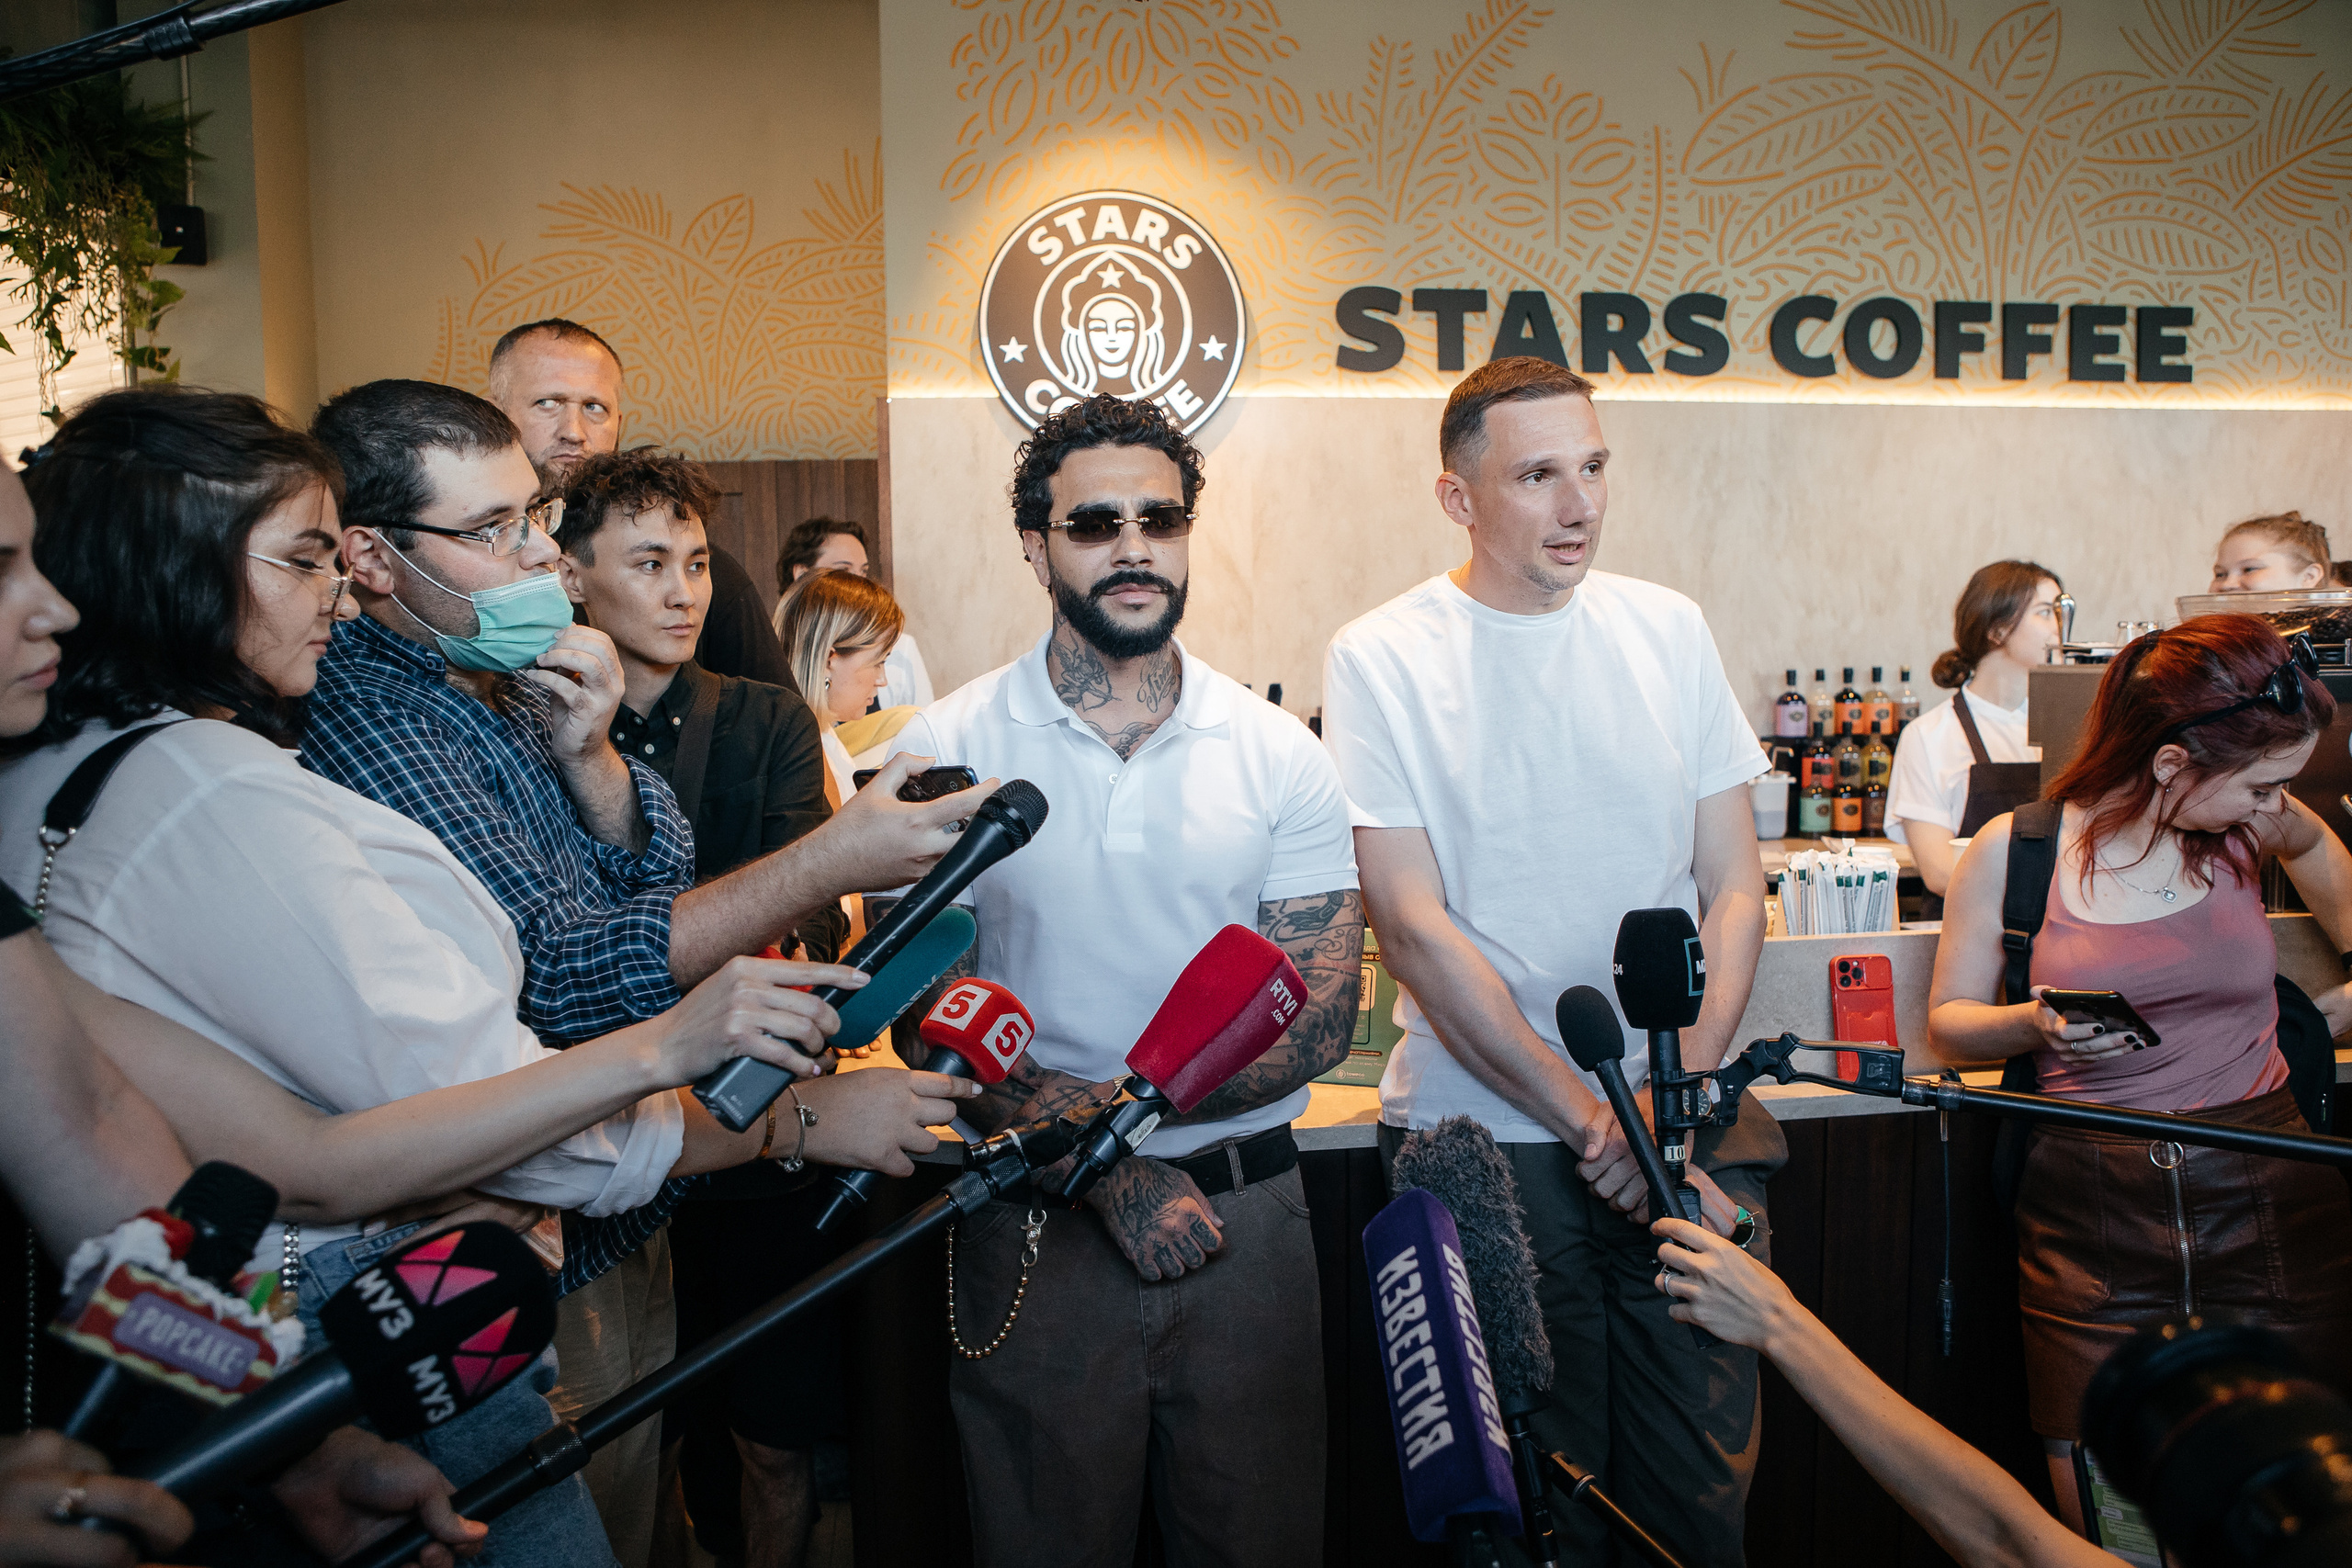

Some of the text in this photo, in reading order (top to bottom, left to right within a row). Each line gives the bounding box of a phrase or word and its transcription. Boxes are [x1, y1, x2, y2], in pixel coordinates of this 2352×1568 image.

[1027, 205, 1203, 269] STARS
[1335, 286, 2193, 383] STARS COFFEE
[942, 989, 978, 1019] 5
[1269, 977, 1298, 1017] RTVI
[1271, 1009, 1285, 1026] .COM
[995, 1021, 1023, 1057] 5
[1668, 1145, 1684, 1159] 10
[355, 1267, 414, 1341] МУЗ
[135, 1306, 243, 1373] POPCAKE
[1376, 1245, 1454, 1471] ИЗВЕСТИЯ
[407, 1354, 458, 1424] МУЗ
